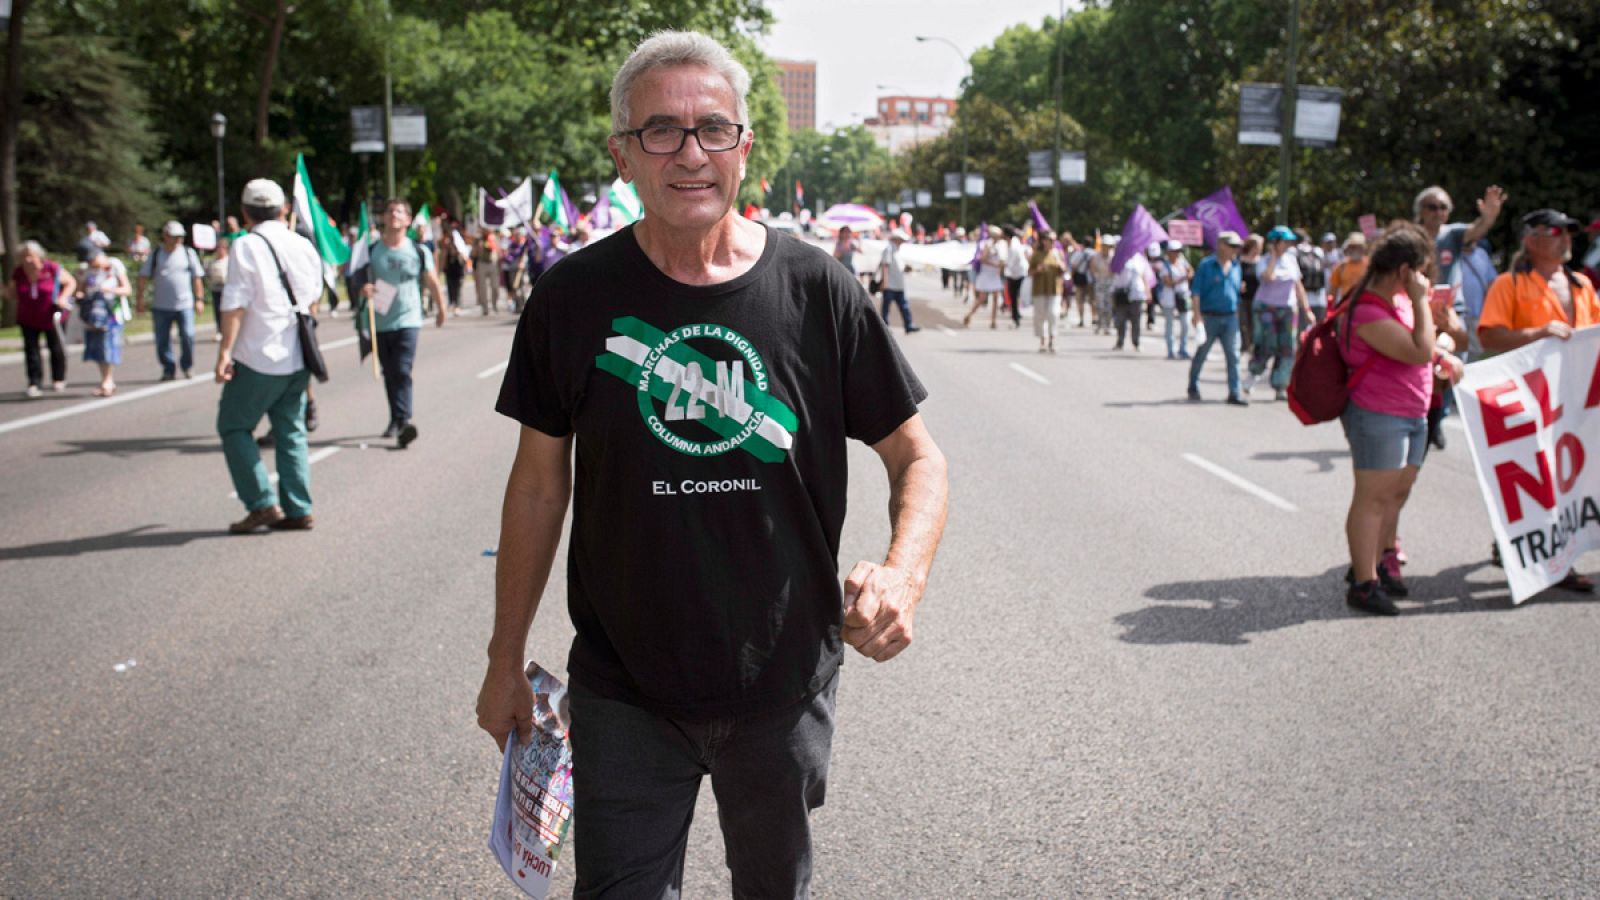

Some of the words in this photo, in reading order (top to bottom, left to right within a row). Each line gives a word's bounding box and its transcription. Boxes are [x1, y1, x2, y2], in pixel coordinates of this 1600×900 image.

[639, 332, 680, 392] MARCHAS
[682, 326, 701, 338] DE
[704, 325, 722, 337] LA
[724, 331, 768, 392] DIGNIDAD
[1476, 368, 1563, 447] EL
[647, 415, 702, 454] COLUMNA
[652, 480, 677, 495] EL
[680, 479, 761, 494] CORONIL
[1494, 432, 1586, 525] NO
[523, 847, 551, 878] LUCHA
